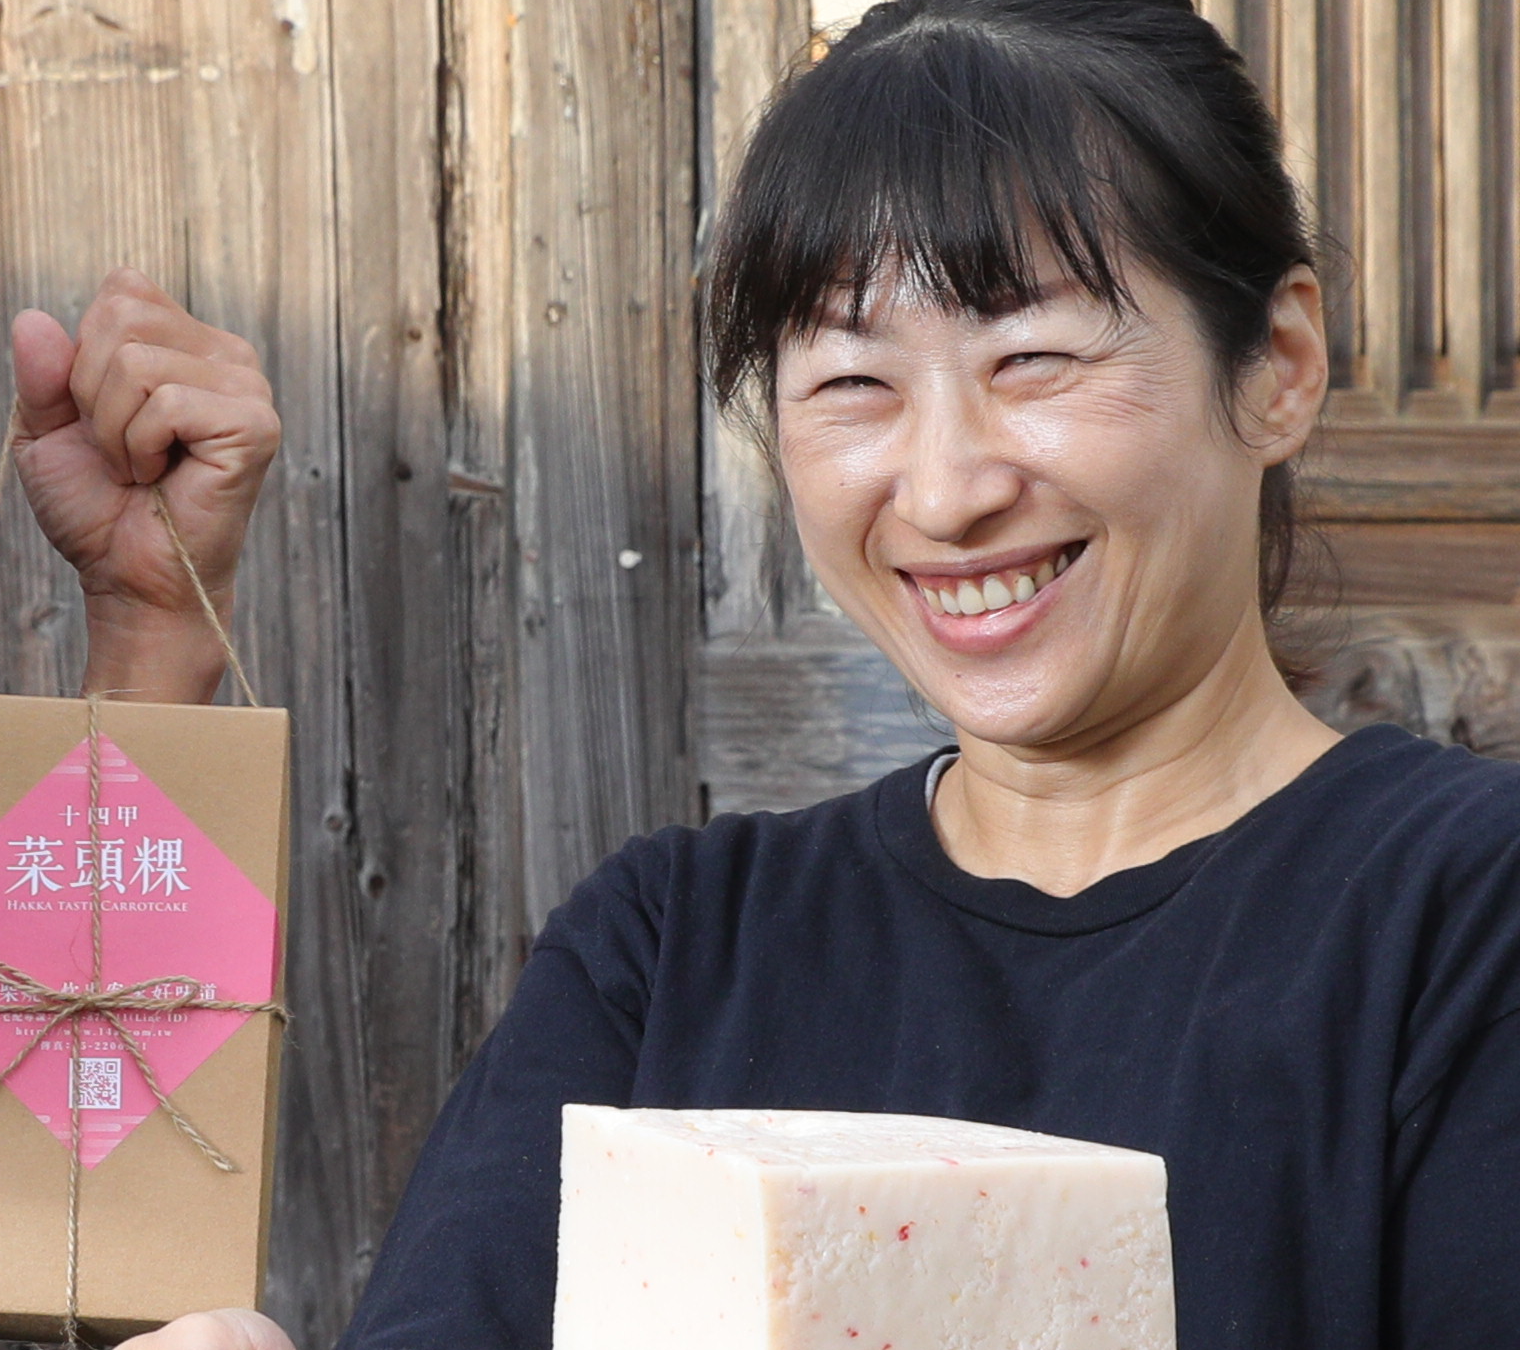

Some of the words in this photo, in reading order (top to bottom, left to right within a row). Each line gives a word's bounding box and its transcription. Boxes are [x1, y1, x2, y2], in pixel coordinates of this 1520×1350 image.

[57, 804, 139, 828] 十四甲
[4, 834, 192, 897] 菜頭粿
[7, 899, 54, 912] HAKKA
[99, 899, 189, 913] CARROTCAKE
